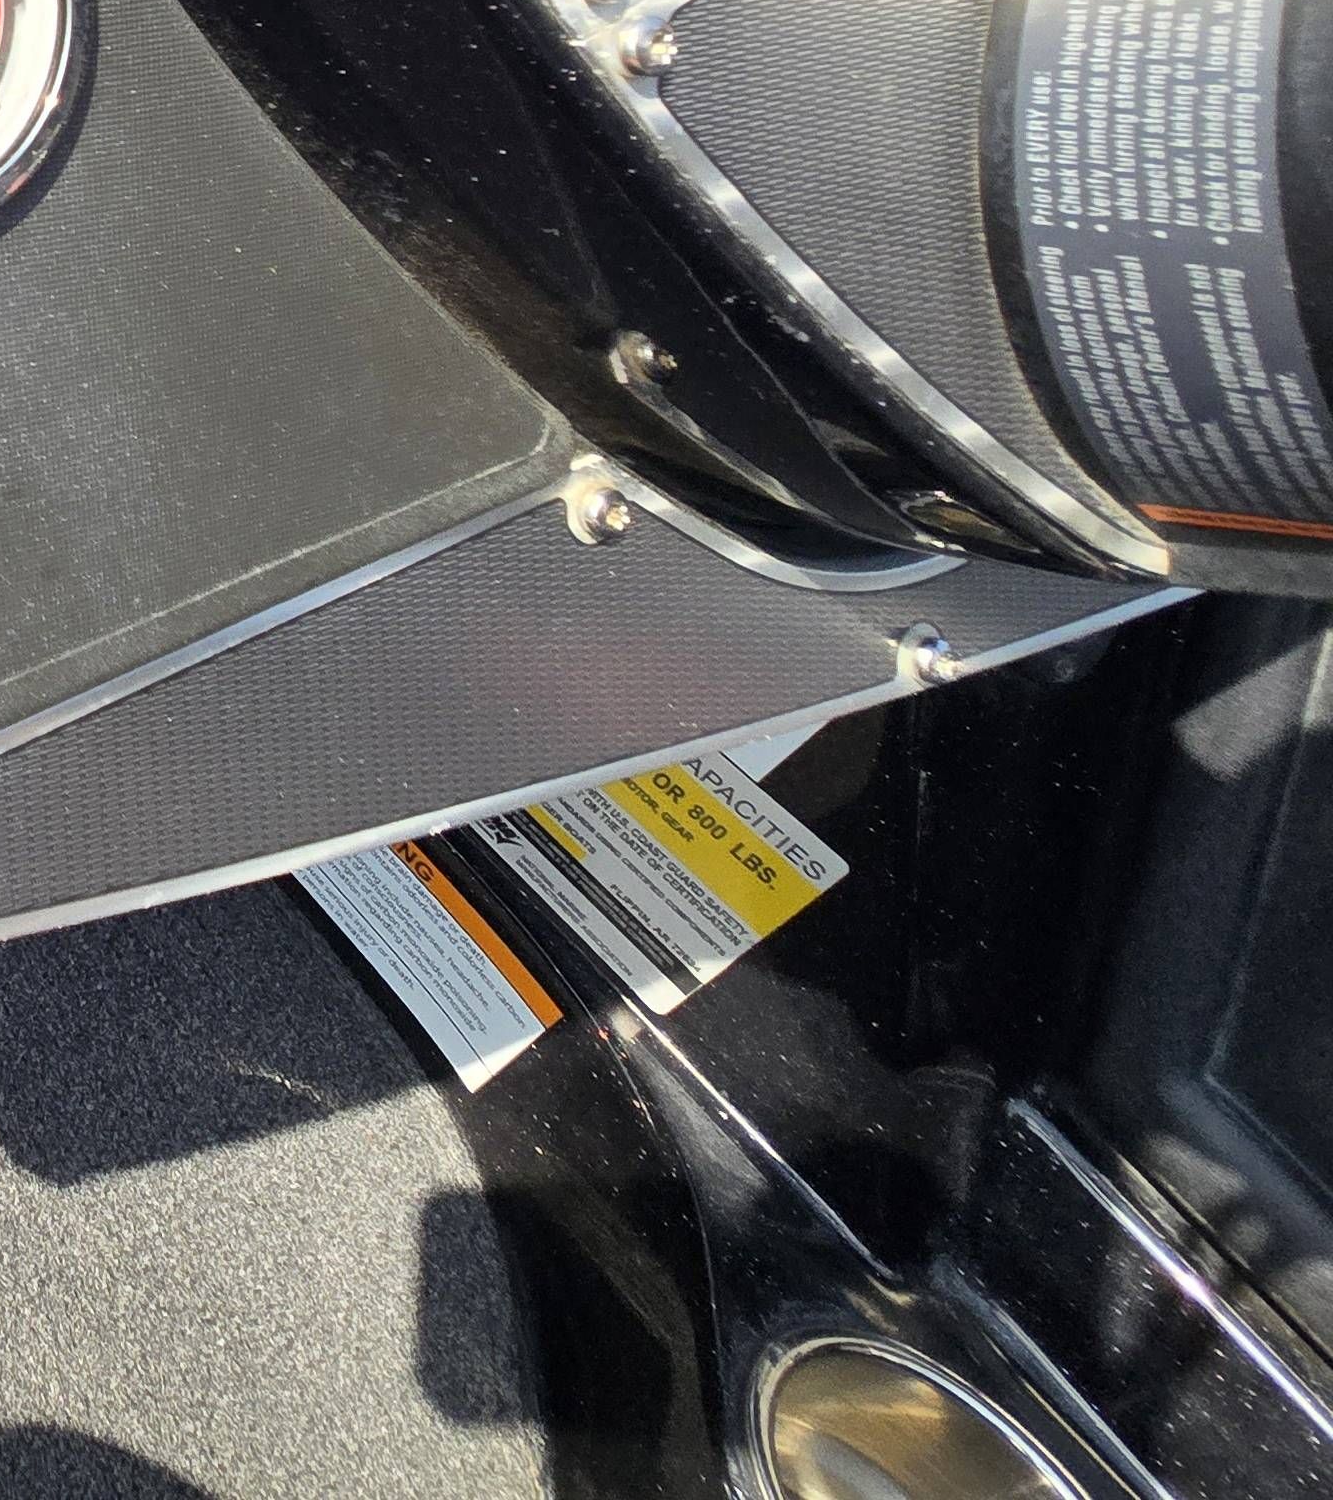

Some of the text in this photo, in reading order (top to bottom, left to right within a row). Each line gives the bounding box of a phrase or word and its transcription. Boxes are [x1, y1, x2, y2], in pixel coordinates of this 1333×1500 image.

[1057, 8, 1088, 65] highest
[1086, 5, 1122, 71] steering
[1142, 11, 1174, 58] hoses
[1055, 69, 1080, 83] in
[1111, 40, 1144, 108] steering
[1141, 64, 1171, 132] steering
[1174, 62, 1196, 79] or
[1053, 87, 1079, 126] level
[1083, 76, 1109, 164] immediate
[1166, 85, 1199, 146] kinking
[1230, 92, 1261, 165] steering
[1025, 108, 1049, 163] EVERY
[1054, 129, 1077, 164] fluid
[1110, 113, 1139, 172] turning
[1140, 137, 1165, 159] all
[1028, 167, 1050, 182] to
[1055, 167, 1082, 214] Check
[1085, 168, 1113, 216] Verify
[1201, 152, 1227, 176] for
[1029, 186, 1054, 225] Prior
[1113, 177, 1139, 220] when
[1143, 163, 1169, 223] Inspect
[1172, 202, 1199, 226] for
[1201, 181, 1233, 232] Check
[1234, 169, 1263, 232] leaking
[1033, 244, 1071, 305] steering
[1065, 274, 1097, 310] from
[1088, 267, 1134, 334] personal
[1113, 254, 1151, 312] Manual
[1181, 262, 1213, 290] not
[1211, 266, 1253, 328] steering
[1075, 312, 1117, 368] ejection
[1129, 315, 1171, 372] Owner's
[1192, 309, 1242, 388] component
[540, 801, 597, 854] GER BOATS
[647, 771, 785, 890] OR 800 LBS.
[658, 811, 696, 842] GEAR
[681, 756, 829, 882] APACITIES
[351, 861, 362, 871] of
[393, 841, 438, 883] NG
[580, 797, 742, 946] ON THE DATE OF CERTIFICATION
[608, 809, 634, 829] U.S.
[628, 828, 669, 862] COAST
[665, 861, 706, 897] GUARD
[702, 895, 748, 937] SAFETY
[301, 874, 336, 910] persons
[334, 910, 345, 919] in
[322, 885, 355, 919] serious
[350, 918, 380, 947] injury
[376, 947, 390, 958] or
[337, 859, 361, 883] signs
[360, 884, 372, 894] of
[369, 895, 402, 928] carbon
[400, 929, 445, 978] monoxide
[380, 884, 415, 920] include
[387, 856, 415, 882] brain
[410, 882, 450, 923] damage
[447, 922, 461, 934] or
[369, 849, 403, 883] ontains
[400, 883, 440, 923] odorless
[438, 924, 459, 945] and
[456, 944, 497, 990] colorless
[494, 990, 527, 1028] carbon
[580, 924, 633, 976] ASSOCIATION
[653, 926, 671, 942] AR
[663, 898, 726, 956] COMPONENTS
[360, 897, 403, 944] regarding
[401, 944, 434, 979] carbon
[431, 978, 477, 1032] monoxide
